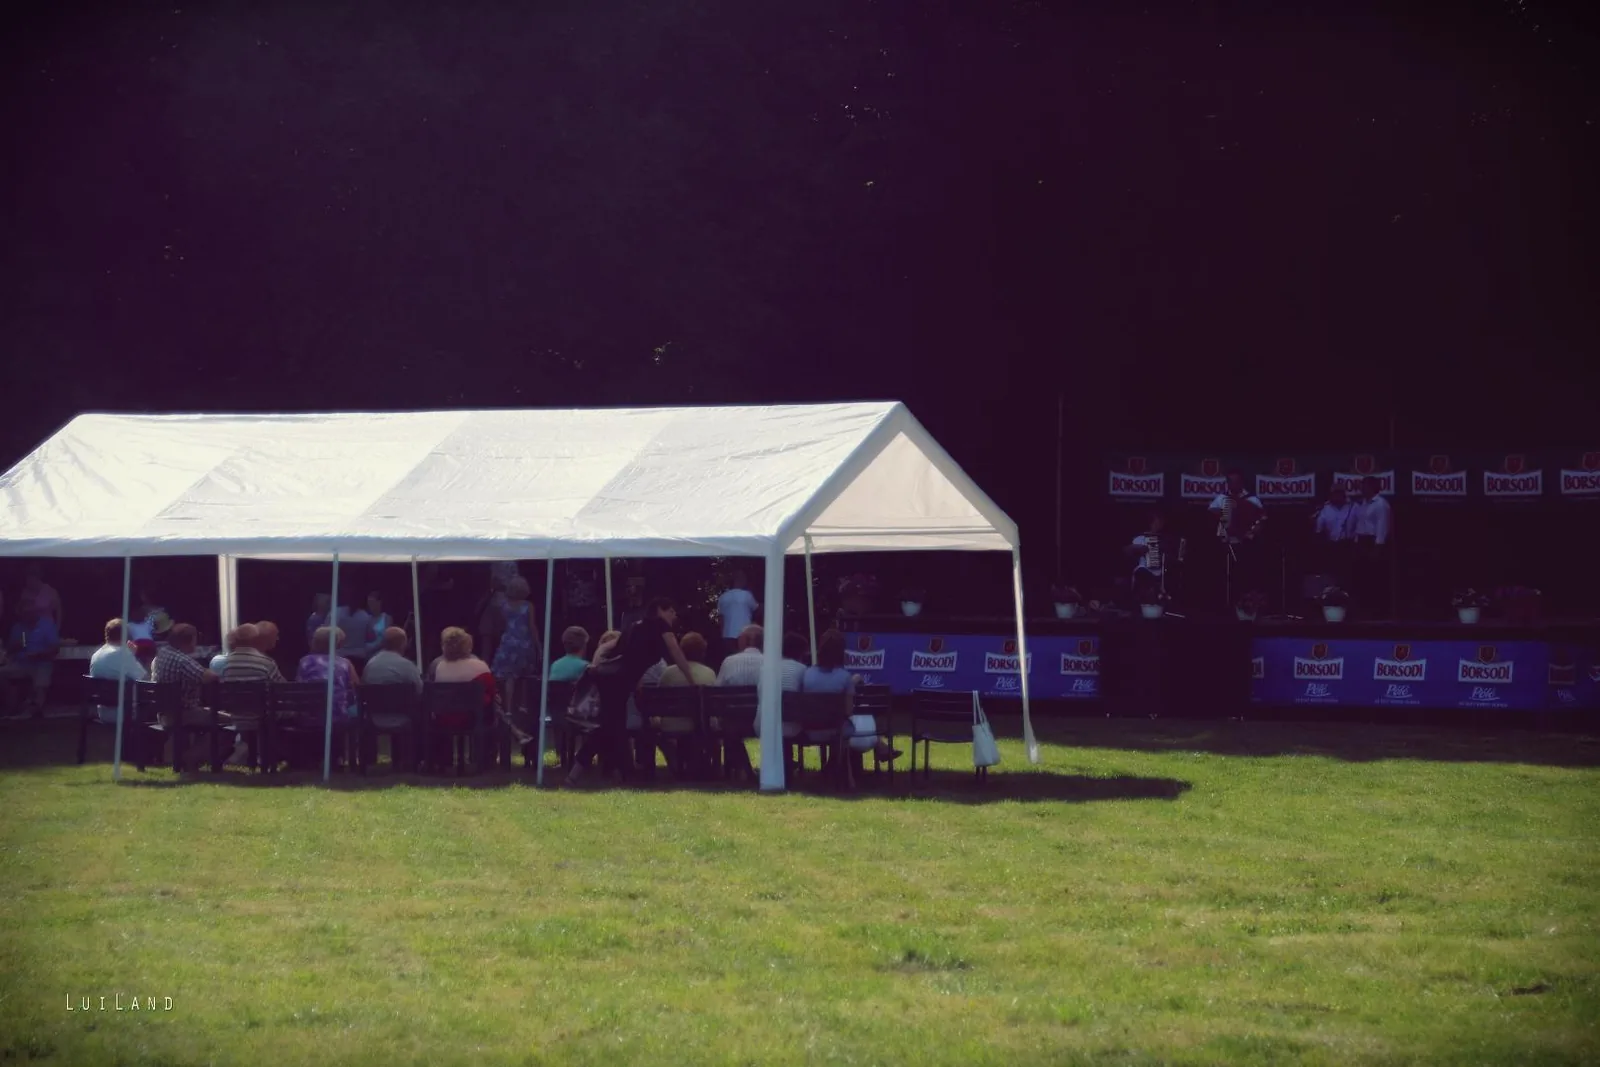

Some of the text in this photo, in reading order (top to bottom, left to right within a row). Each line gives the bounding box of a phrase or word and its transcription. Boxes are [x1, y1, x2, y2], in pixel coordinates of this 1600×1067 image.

[1112, 476, 1160, 493] BORSODI
[1183, 478, 1226, 494] BORSO
[1258, 479, 1312, 495] BORSODI
[1415, 476, 1464, 491] BORSODI
[1487, 476, 1539, 492] BORSODI
[1564, 473, 1600, 490] BORSO
[914, 655, 954, 669] BORSODI
[1296, 662, 1340, 676] BORSODI
[1376, 663, 1422, 677] BORSODI
[1461, 665, 1510, 679] BORSODI
